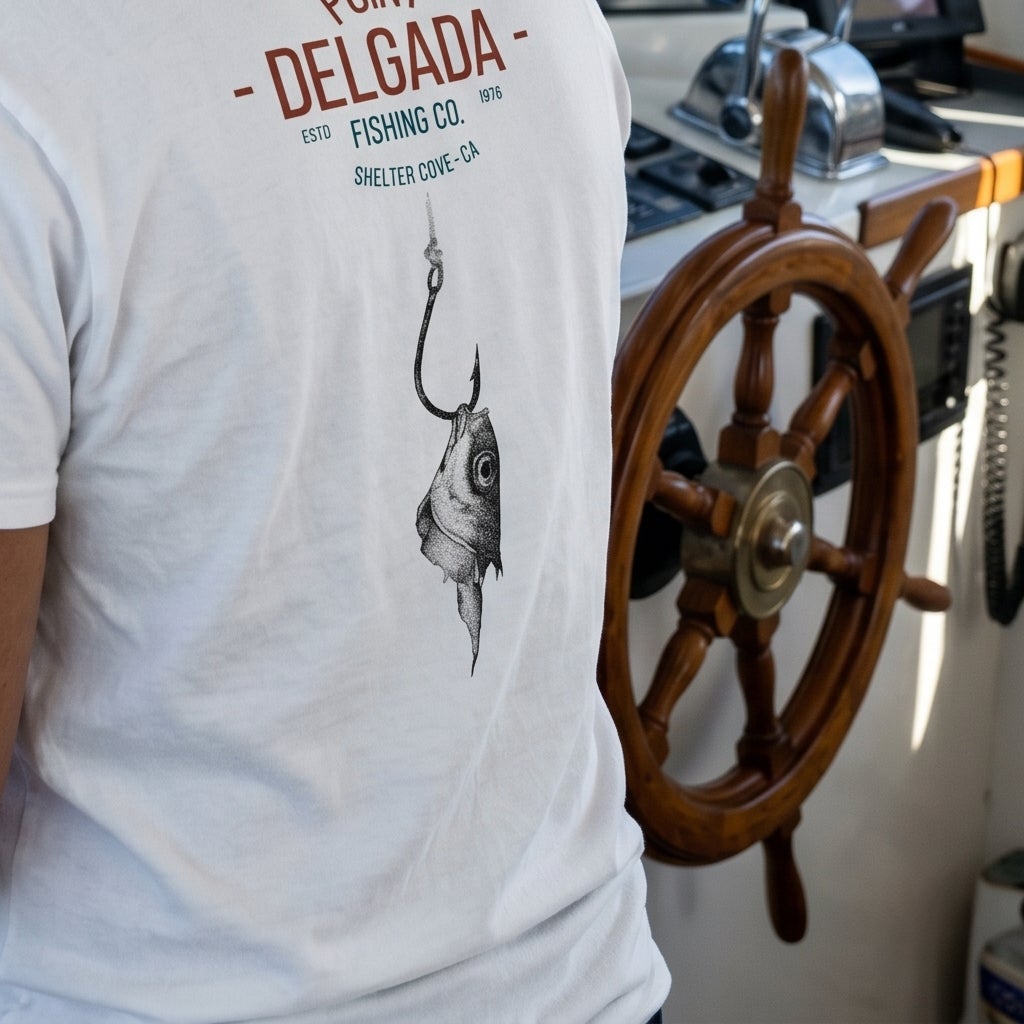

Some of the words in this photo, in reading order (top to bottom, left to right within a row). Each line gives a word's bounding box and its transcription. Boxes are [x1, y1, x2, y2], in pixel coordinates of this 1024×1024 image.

[264, 8, 507, 120] DELGADA
[478, 85, 503, 103] 1976
[301, 124, 332, 144] ESTD
[349, 105, 430, 149] FISHING
[432, 98, 465, 130] CO.
[354, 165, 416, 187] SHELTER
